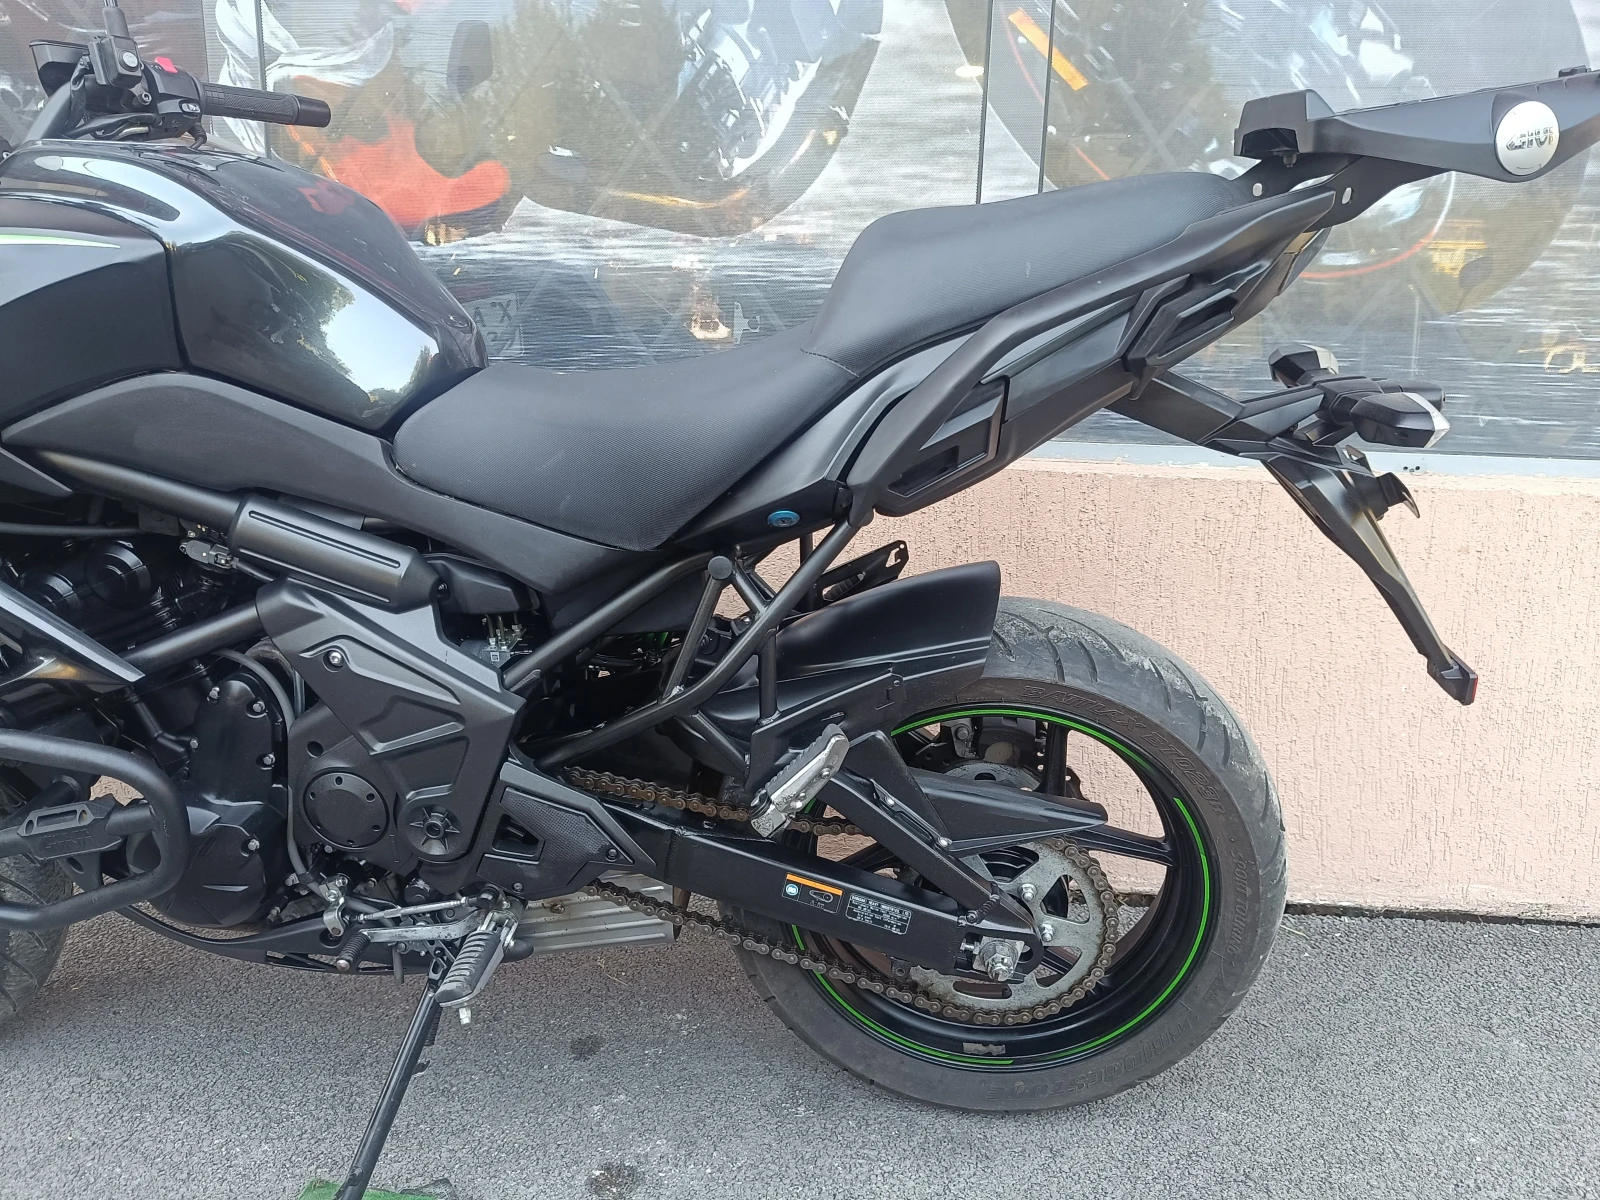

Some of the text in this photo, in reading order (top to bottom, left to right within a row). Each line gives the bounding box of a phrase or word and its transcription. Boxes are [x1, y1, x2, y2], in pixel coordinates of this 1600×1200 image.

[1506, 127, 1553, 151] GIVI
[1020, 685, 1146, 732] BATTLAX
[1226, 850, 1249, 957] SPORT TOURING
